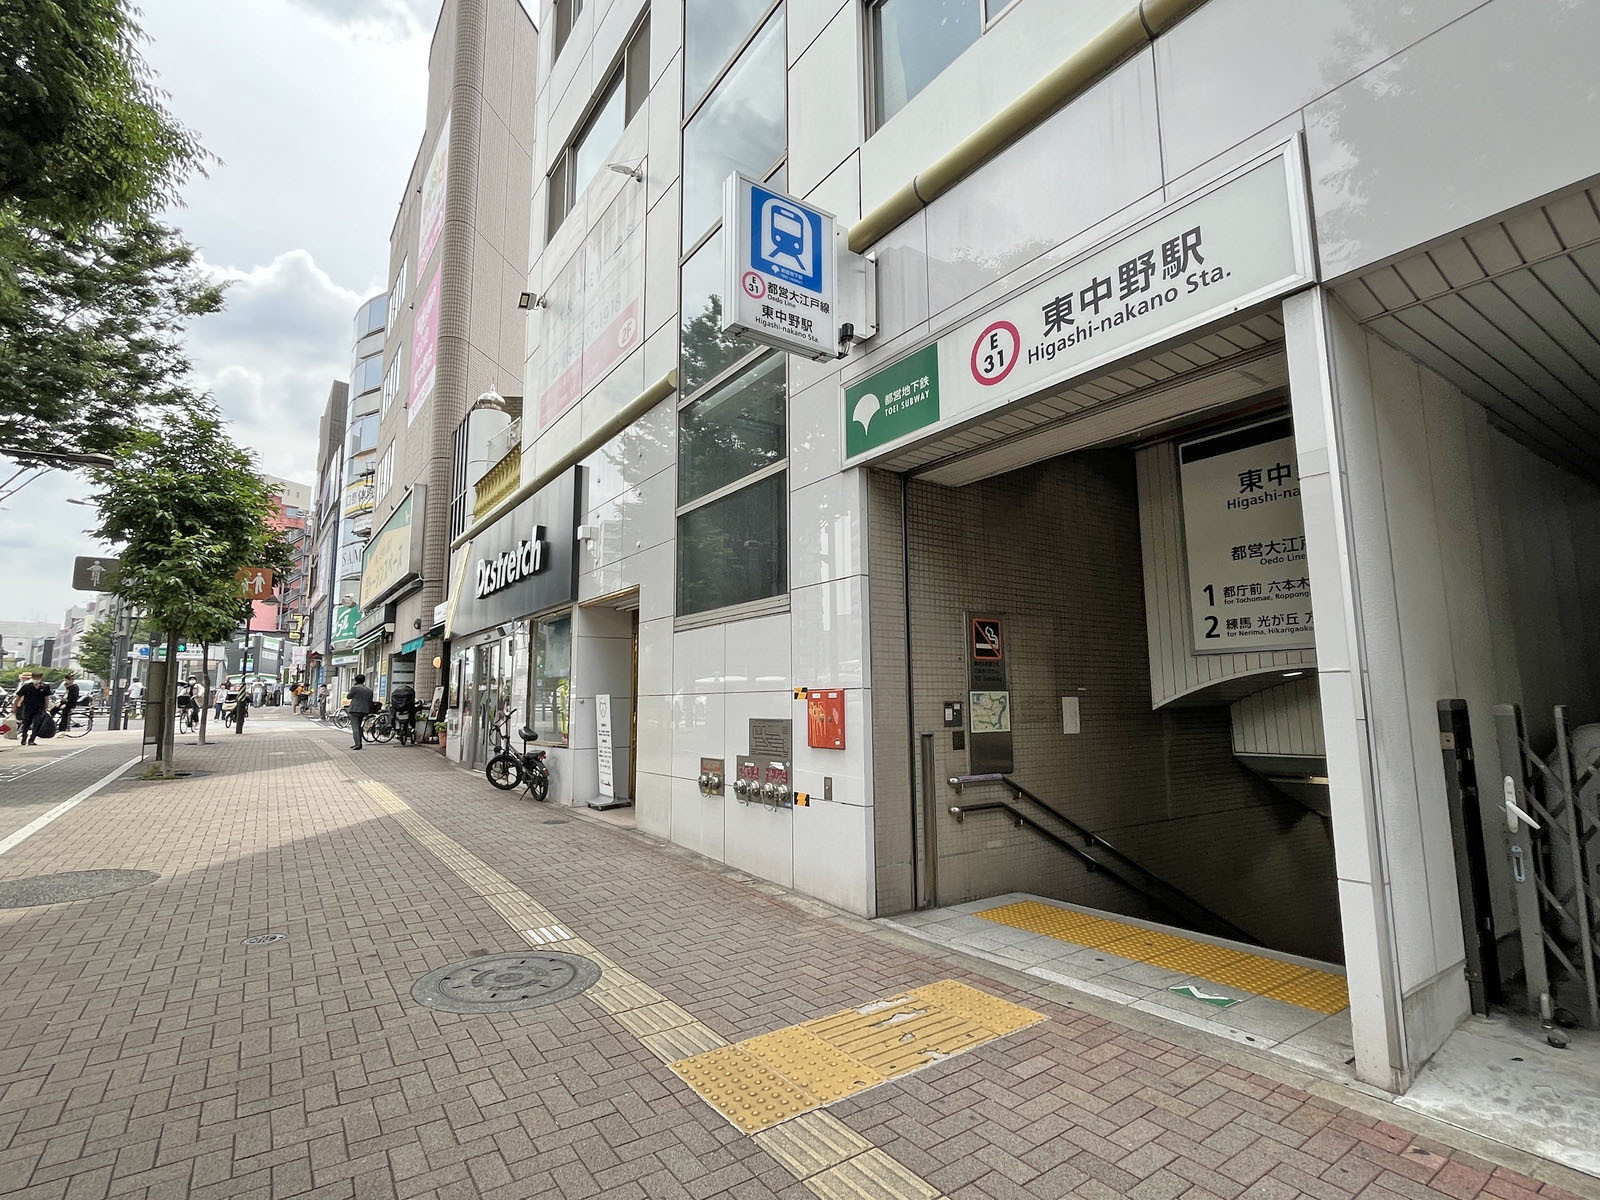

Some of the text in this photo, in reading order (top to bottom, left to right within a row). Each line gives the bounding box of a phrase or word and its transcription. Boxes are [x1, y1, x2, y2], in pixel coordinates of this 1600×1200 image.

[748, 283, 759, 294] 31
[752, 276, 757, 284] E
[1042, 225, 1204, 337] 東中野駅
[767, 281, 830, 314] 都営大江戸線
[767, 293, 796, 309] Oedo Line
[762, 304, 813, 333] 東中野駅
[1028, 266, 1231, 364] Higashi-nakano Sta.
[621, 320, 633, 344] 2F
[755, 316, 807, 339] Higashi-nakano
[990, 332, 998, 350] E
[983, 349, 1004, 374] 31
[884, 375, 930, 406] 都営地下鉄
[884, 389, 930, 416] TOEI SUBWAY
[1238, 463, 1300, 494] 東中
[1260, 553, 1306, 565] Oedo Line
[1203, 584, 1214, 606] 1
[1223, 577, 1310, 598] 都庁前 六本木
[1236, 595, 1273, 604] Tochomae,
[1275, 591, 1311, 600] Roppong
[1204, 615, 1220, 638] 2
[1225, 616, 1252, 631] 練馬
[1257, 612, 1300, 628] 光が丘
[1239, 629, 1266, 637] Nerima,
